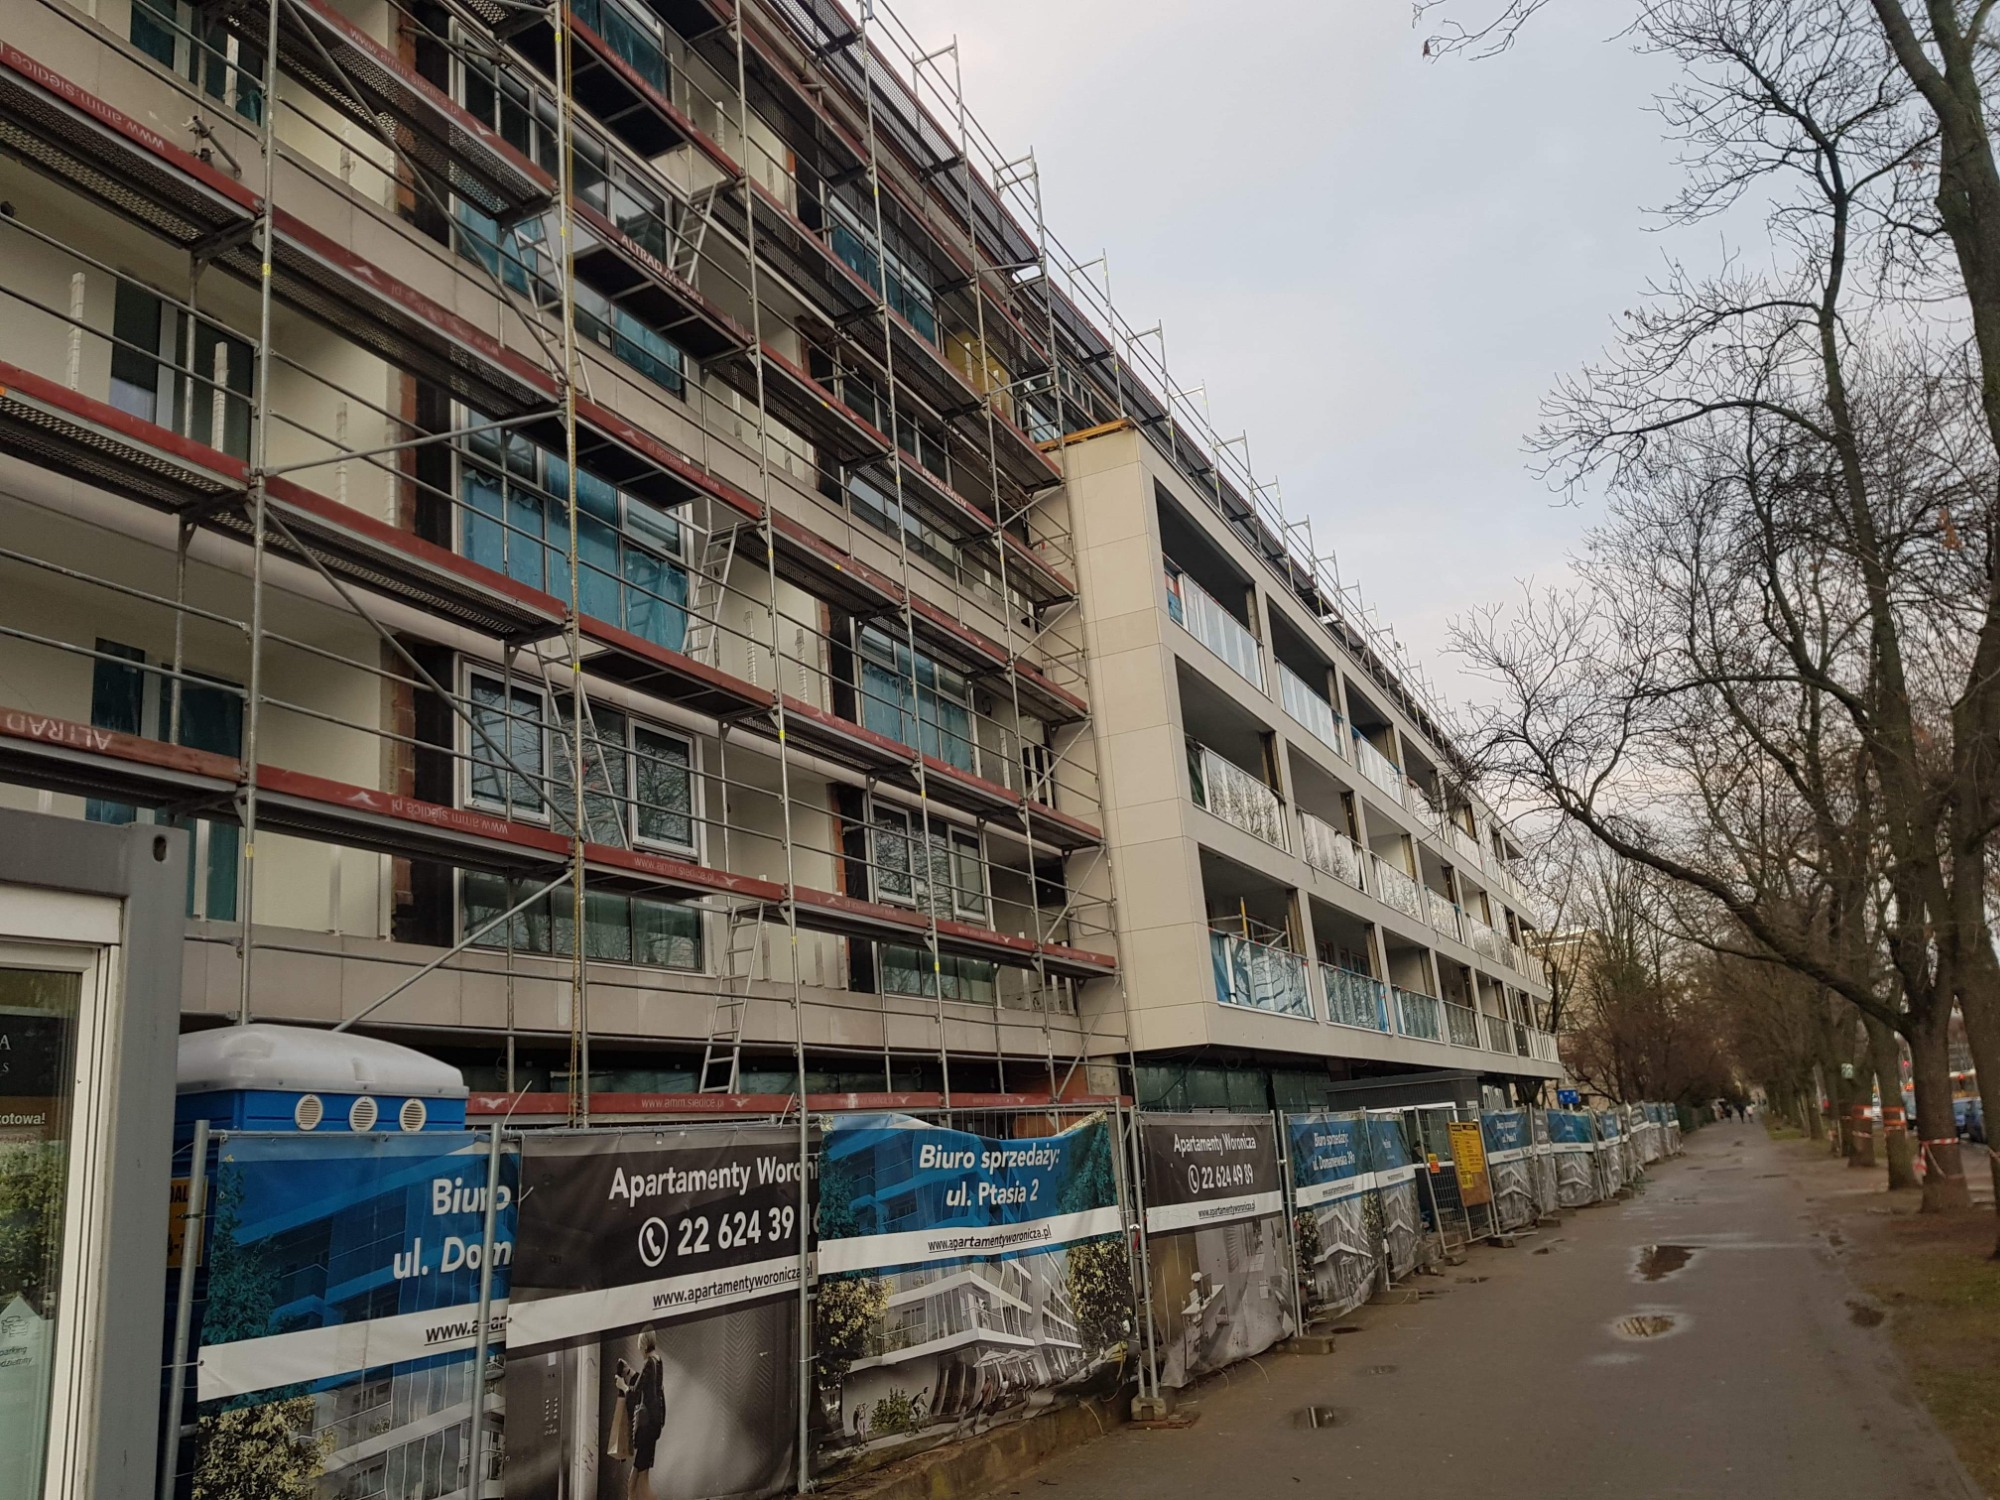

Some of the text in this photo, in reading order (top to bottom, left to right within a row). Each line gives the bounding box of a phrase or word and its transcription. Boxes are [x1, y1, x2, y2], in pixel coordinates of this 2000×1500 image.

[621, 235, 663, 273] ALTRAD
[6, 712, 113, 750] ALTRAD
[919, 1142, 1061, 1175] Biuro sprzedaży:
[1174, 1132, 1257, 1158] Apartamenty Woronicza
[609, 1161, 751, 1207] Apartamenty
[946, 1178, 1040, 1206] ul. Ptasia 2
[1201, 1163, 1254, 1189] 22 624 49 89
[677, 1216, 710, 1256] 22
[718, 1210, 761, 1249] 624
[768, 1205, 795, 1241] 39
[928, 1224, 1052, 1251] www.apartamentyworonicza.pl
[393, 1237, 428, 1279] ul.
